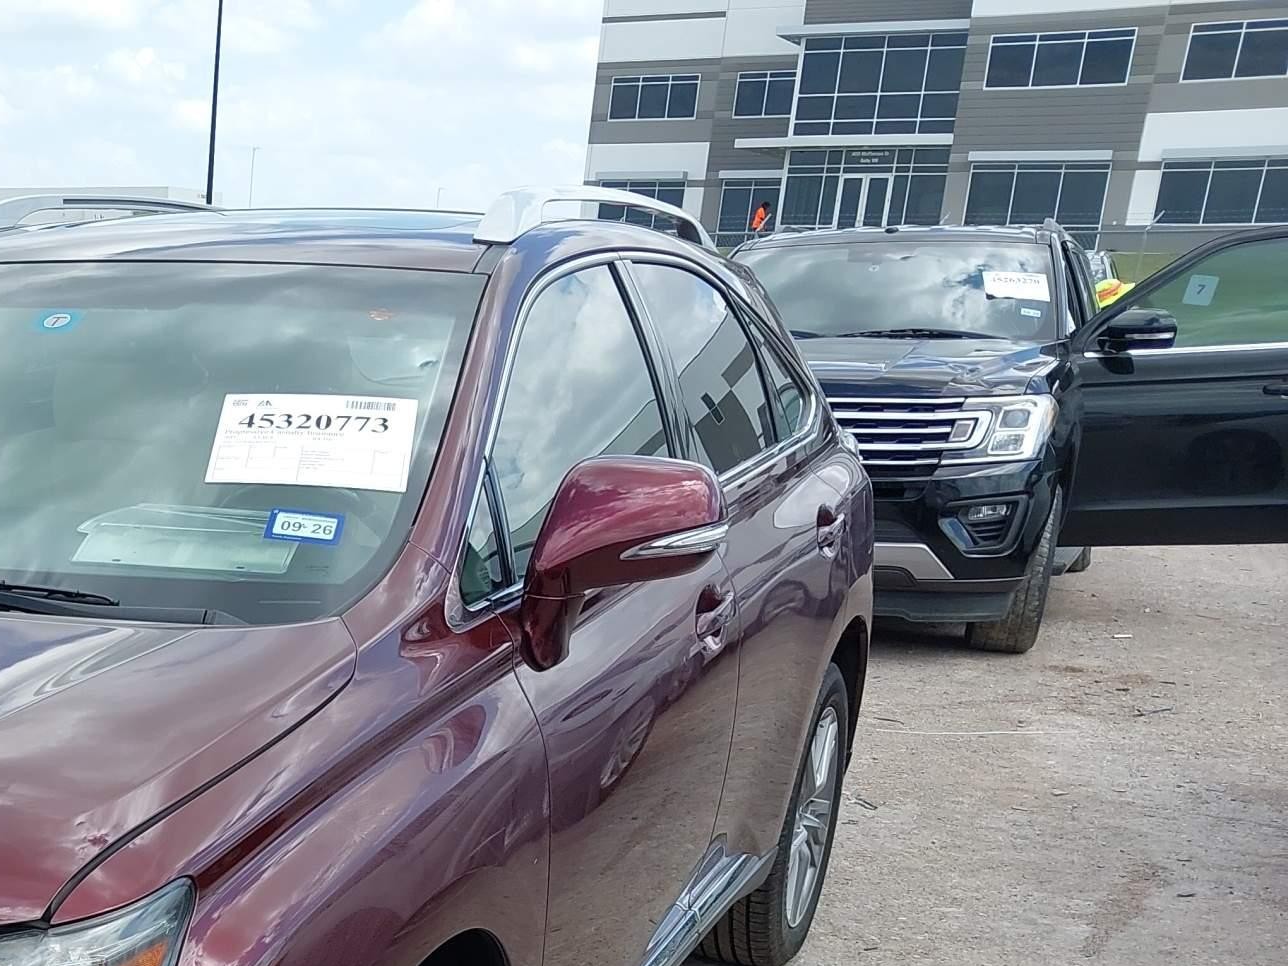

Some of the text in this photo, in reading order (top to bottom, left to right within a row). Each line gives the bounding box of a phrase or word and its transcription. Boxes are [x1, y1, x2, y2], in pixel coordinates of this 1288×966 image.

[1196, 284, 1206, 295] 7
[238, 413, 390, 433] 45320773
[280, 520, 333, 535] 09 26
